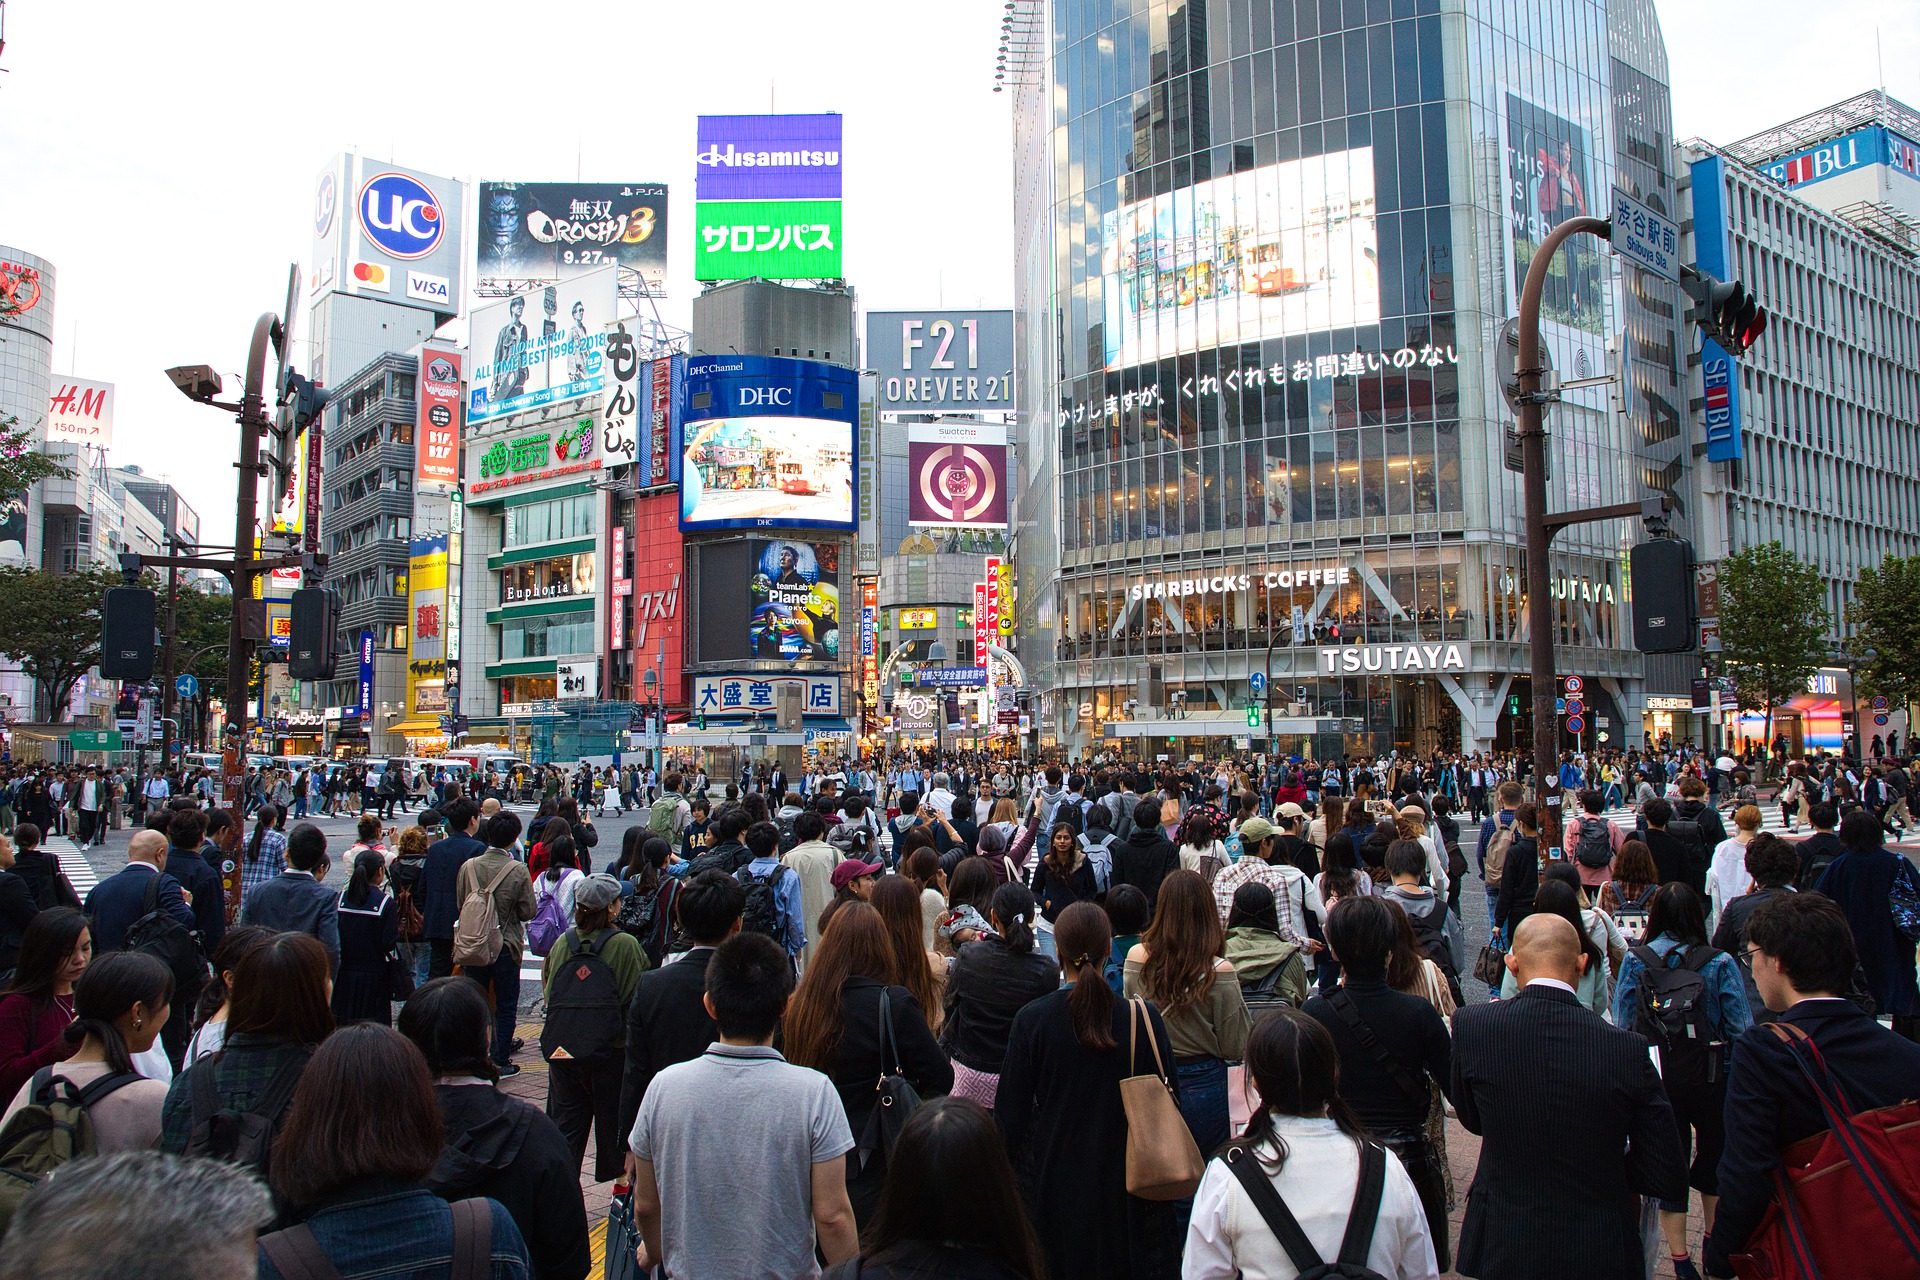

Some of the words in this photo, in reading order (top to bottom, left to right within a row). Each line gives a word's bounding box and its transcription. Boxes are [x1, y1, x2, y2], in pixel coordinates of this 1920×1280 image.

[696, 144, 839, 167] Hisamitsu
[1508, 147, 1545, 179] THIS
[636, 188, 665, 196] PS4
[368, 188, 436, 240] UC
[569, 198, 613, 221] 無双
[527, 210, 629, 246] OROCHI
[622, 207, 657, 244] 3
[701, 223, 834, 253] サロンパス
[1617, 199, 1675, 256] 渋谷駅前
[1626, 235, 1654, 262] Shibuya
[1655, 251, 1669, 270] Sta.
[411, 277, 447, 297] VISA
[902, 319, 978, 370] F21
[474, 364, 491, 381] ALL
[494, 356, 519, 375] TIME
[521, 349, 547, 368] BEST
[690, 365, 708, 376] DHC
[709, 362, 743, 373] Channel
[50, 384, 106, 420] H&M
[535, 390, 550, 403] Song
[603, 322, 637, 461] もんじゃ
[739, 387, 792, 406] DHC
[880, 376, 980, 402] OREVER
[985, 375, 1009, 401] 21
[1705, 358, 1731, 445] SEIBU
[652, 362, 667, 478] 三千里薬品
[939, 428, 970, 436] swatch
[429, 430, 451, 445] B1F
[428, 444, 451, 459] B2F
[510, 442, 549, 471] 西村
[506, 581, 569, 601] Euphoria
[776, 582, 808, 592] teamLab
[1132, 574, 1250, 600] STARBUCKS
[1264, 567, 1350, 589] COFFEE
[769, 590, 822, 605] Planets
[416, 604, 440, 640] 薬
[781, 617, 810, 626] TOYOSU
[1000, 619, 1010, 628] 4F
[1322, 645, 1464, 672] TSUTAYA
[701, 682, 833, 707] 大盛堂店
